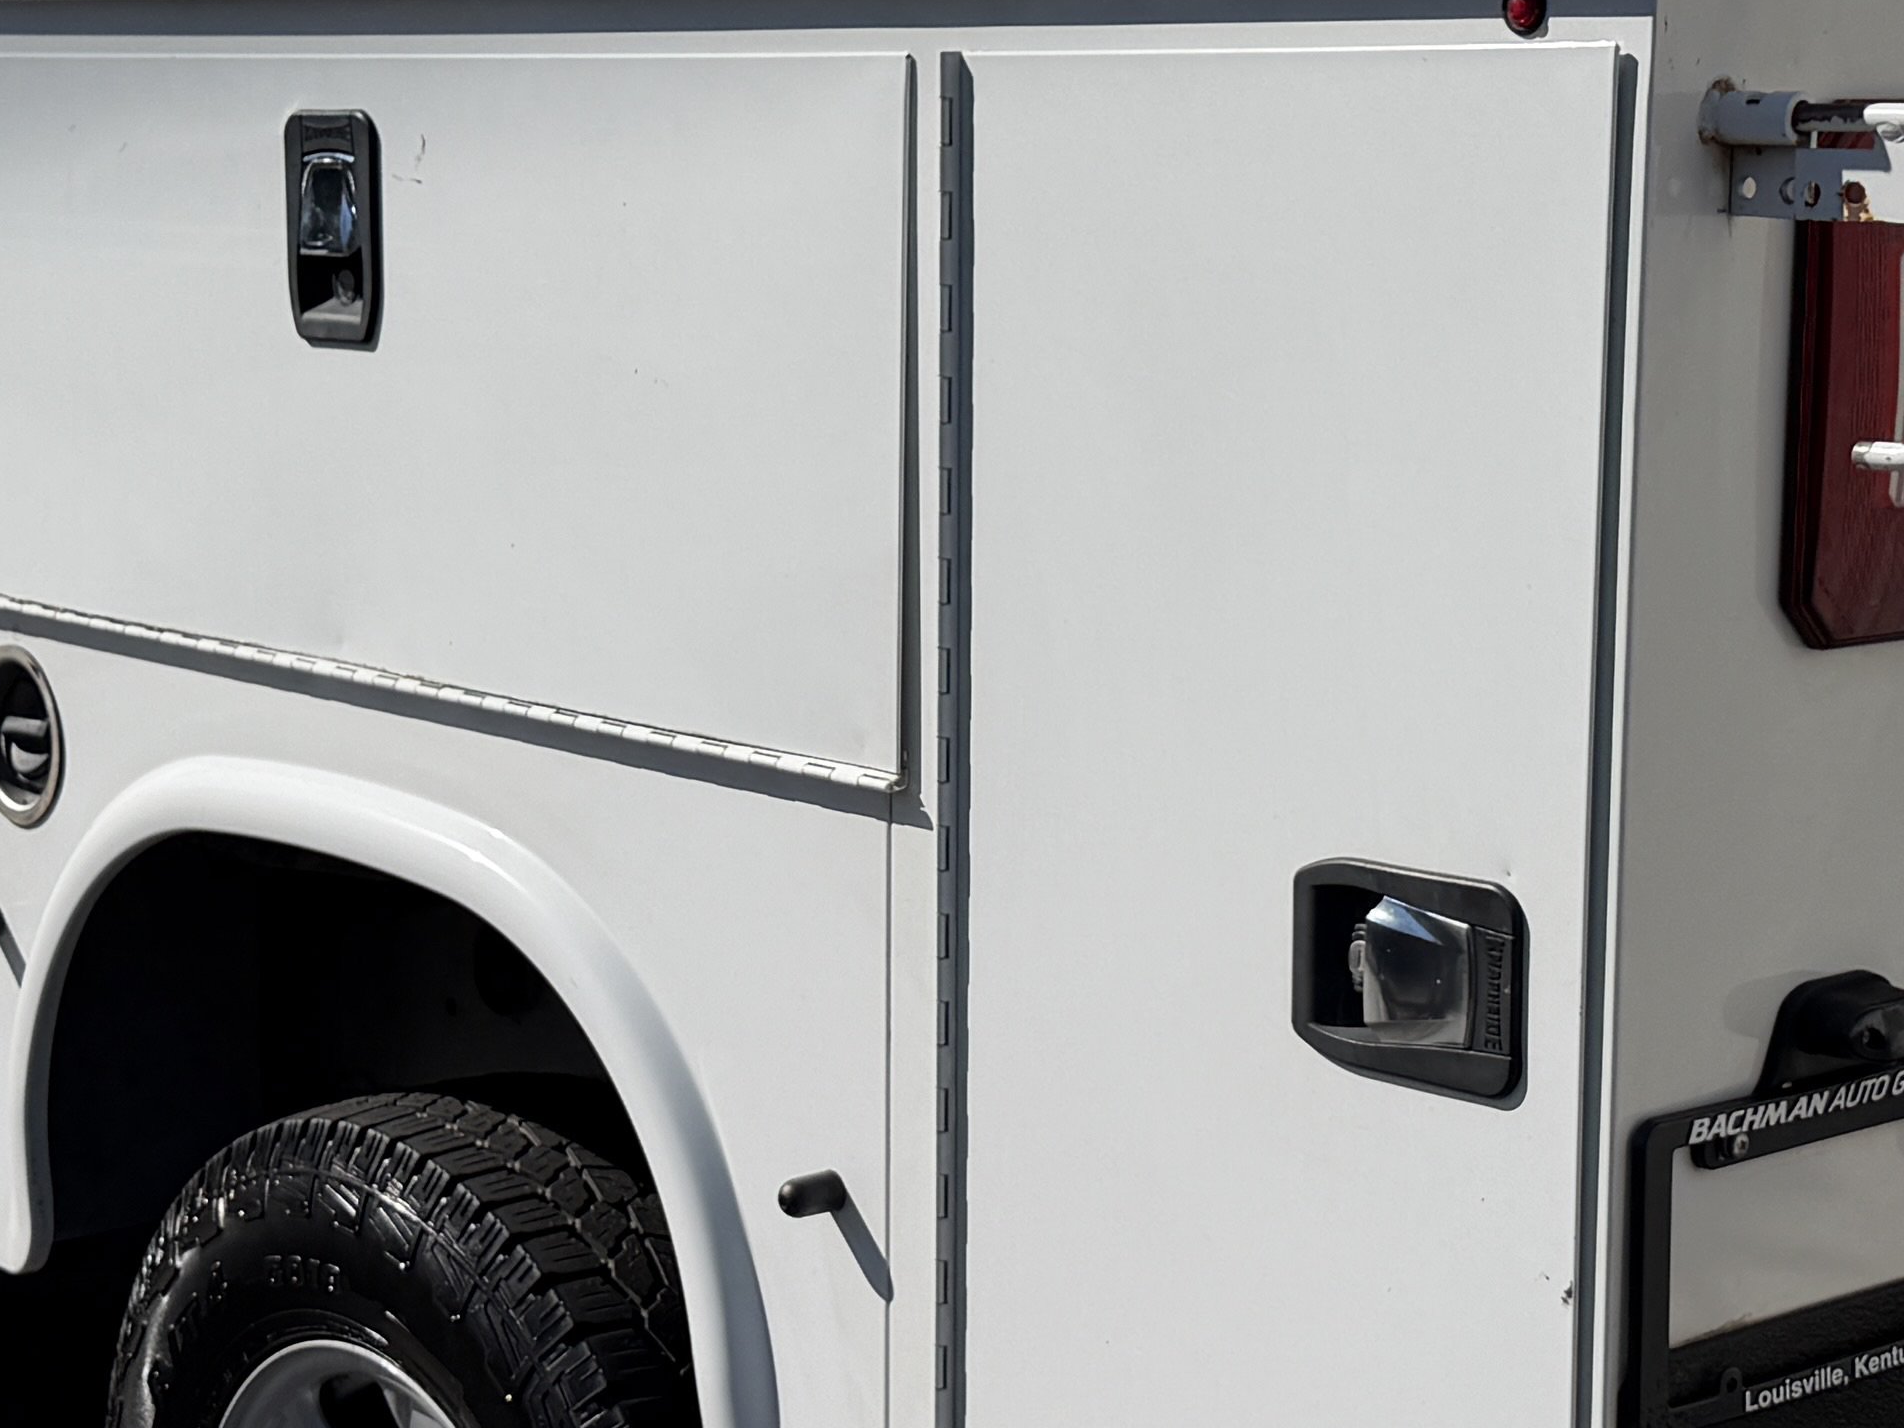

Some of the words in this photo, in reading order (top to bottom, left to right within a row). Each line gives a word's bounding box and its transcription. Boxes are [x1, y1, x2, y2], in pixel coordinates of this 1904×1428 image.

[1688, 1090, 1829, 1144] BACHMAN
[1828, 1074, 1890, 1112] AUTO
[1745, 1365, 1849, 1413] Louisville,
